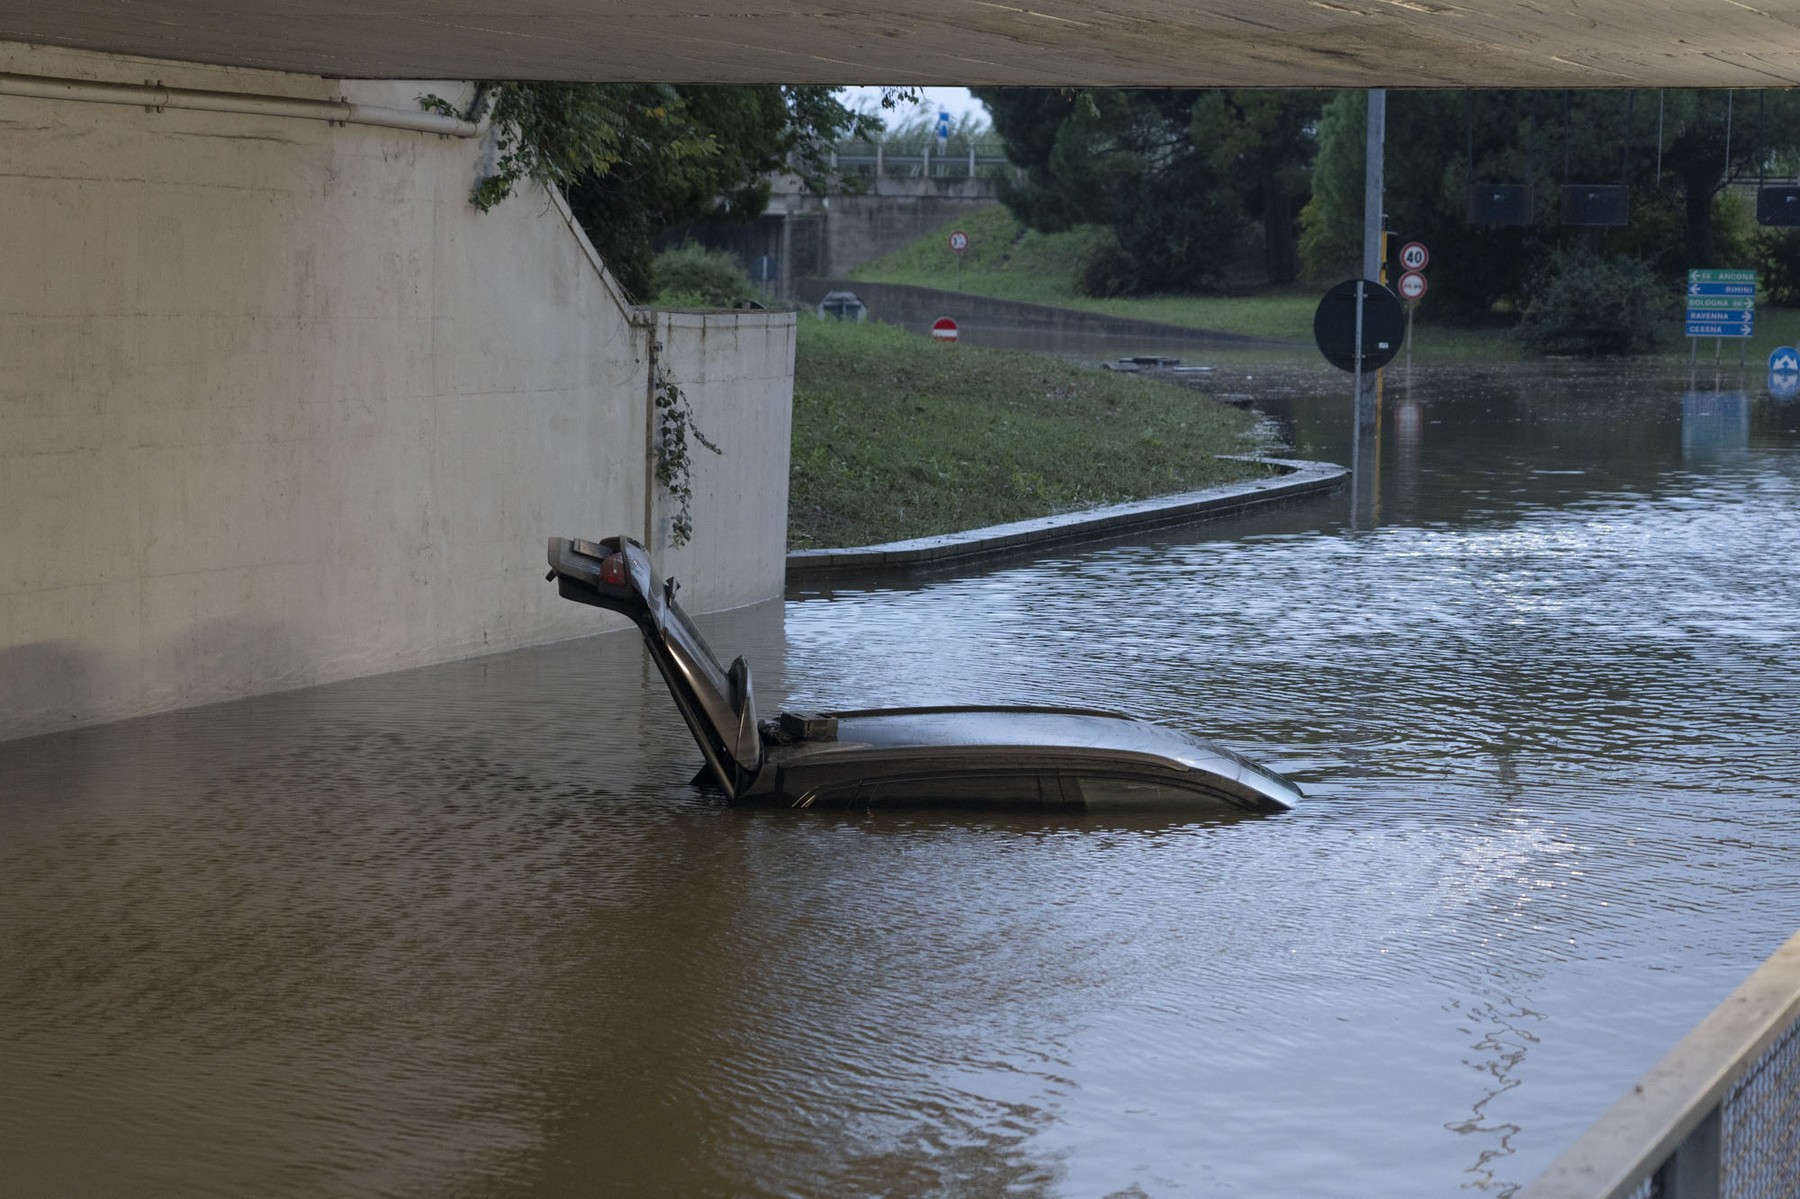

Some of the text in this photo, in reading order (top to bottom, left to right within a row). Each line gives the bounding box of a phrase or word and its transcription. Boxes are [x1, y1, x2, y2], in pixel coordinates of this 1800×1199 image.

[1406, 250, 1422, 264] 40
[1718, 272, 1754, 281] ANCONA
[1724, 286, 1753, 294] RIMINI
[1688, 299, 1729, 307] BOLOGNA
[1690, 312, 1729, 320] RAVENNA
[1689, 325, 1722, 333] CESENA
